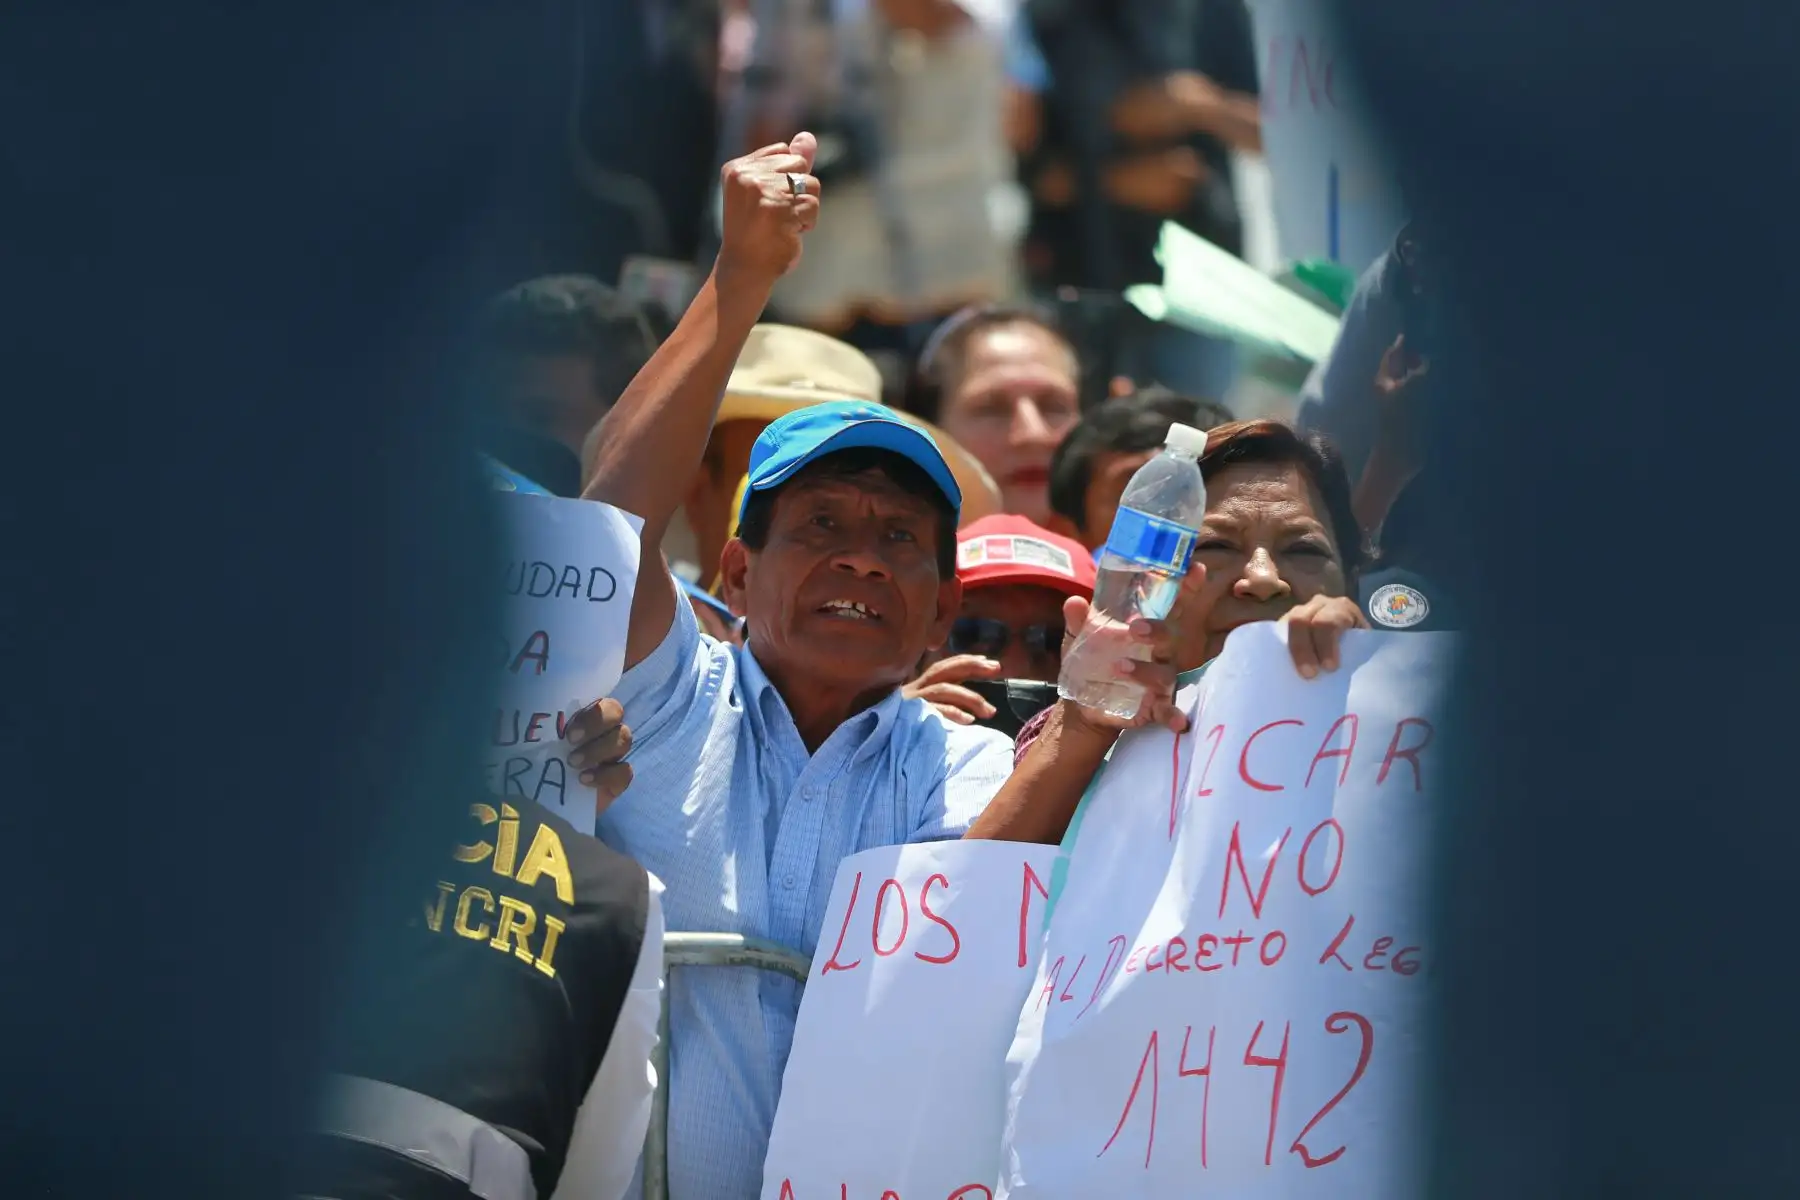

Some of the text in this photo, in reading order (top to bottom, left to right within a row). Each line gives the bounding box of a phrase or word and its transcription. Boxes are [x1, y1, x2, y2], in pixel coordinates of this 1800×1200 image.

[1218, 818, 1345, 920] NO
[821, 871, 960, 976] LOS
[1077, 932, 1287, 1020] DECRETO
[1097, 1010, 1374, 1169] 1442
